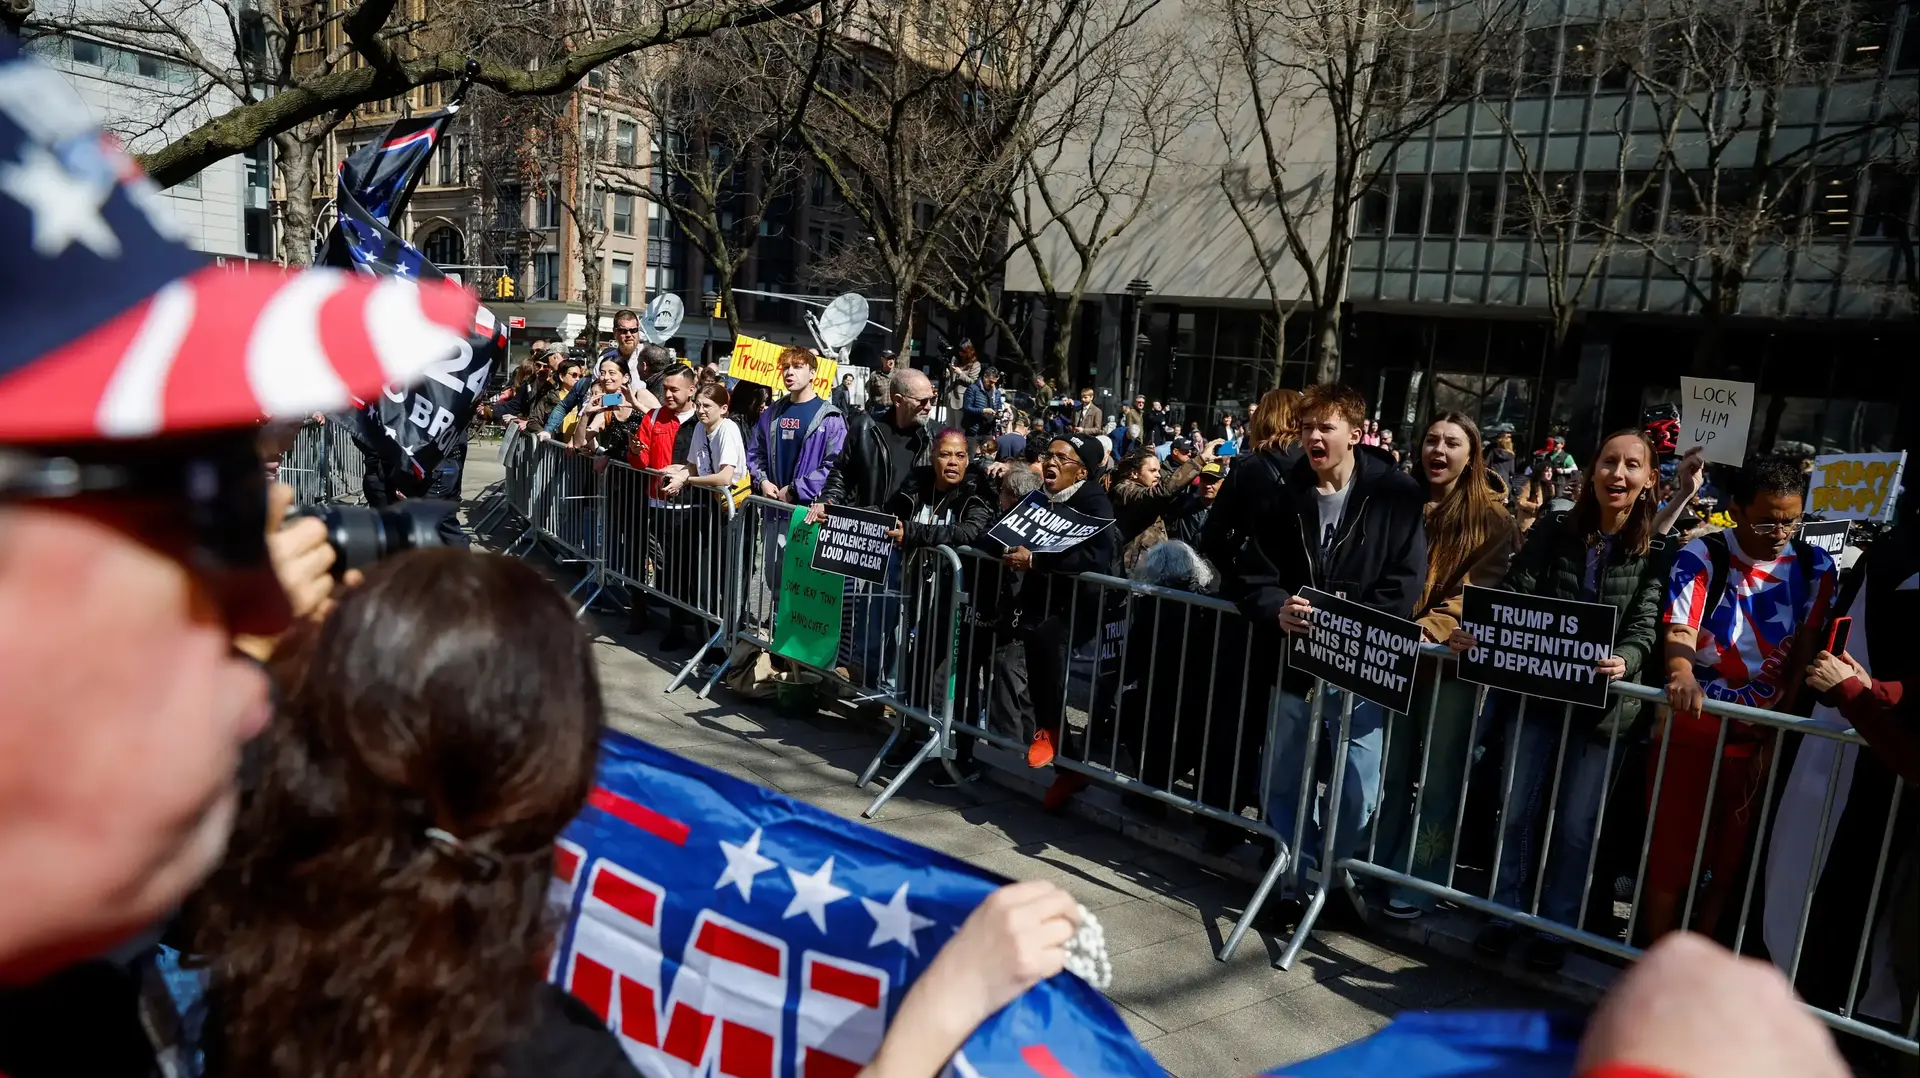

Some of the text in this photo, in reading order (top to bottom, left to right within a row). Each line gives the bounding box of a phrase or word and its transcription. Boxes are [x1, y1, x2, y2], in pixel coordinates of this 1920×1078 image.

[736, 344, 775, 376] Trump
[1693, 385, 1737, 407] LOCK
[780, 417, 800, 429] USA
[1700, 408, 1729, 428] HIM
[1694, 428, 1716, 445] UP
[827, 514, 890, 539] TRUMP'S THREATS
[1001, 513, 1032, 538] ALL
[1029, 528, 1061, 547] THE
[1024, 502, 1100, 536] TRUMP LIES
[819, 528, 891, 556] OF VIOLENCE SPEAK
[821, 544, 882, 571] LOUD AND CLEAR
[785, 579, 800, 595] SOME
[791, 610, 829, 636] HANDCUFFS
[1491, 603, 1579, 635] TRUMP IS
[1308, 625, 1400, 670] THIS IS NOT
[1366, 625, 1419, 657] KNOW
[1463, 621, 1610, 662] THE DEFINITION
[1294, 637, 1408, 693] A WITCH HUNT
[1467, 646, 1597, 685] OF DEPRAVITY
